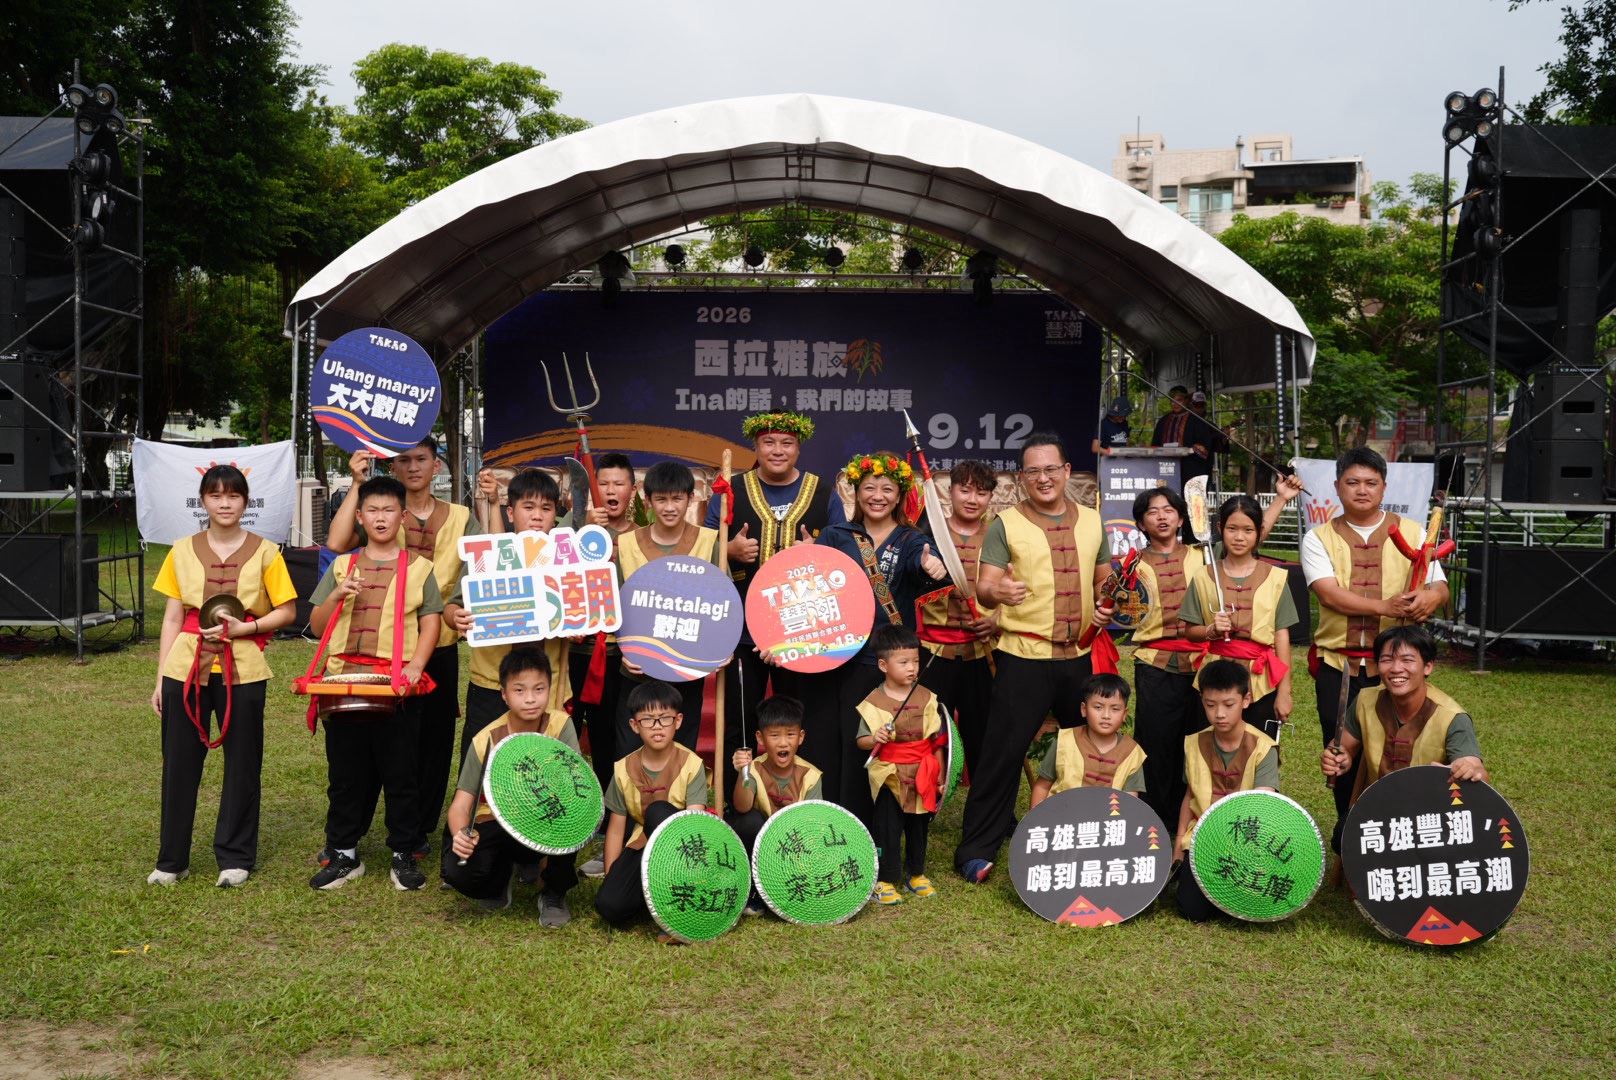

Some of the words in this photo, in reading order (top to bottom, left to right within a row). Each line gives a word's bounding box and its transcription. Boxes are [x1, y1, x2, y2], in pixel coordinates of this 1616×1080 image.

[697, 307, 751, 323] 2026
[369, 334, 408, 352] TAKAO
[695, 340, 848, 377] 西拉雅族
[322, 358, 375, 389] Uhang
[376, 376, 435, 403] maray!
[326, 382, 419, 427] 大大歡欣
[928, 413, 1034, 449] 9.12
[464, 530, 608, 574] TAKAO
[666, 561, 705, 575] TAKAO
[761, 569, 847, 608] TAKAO
[786, 564, 815, 580] 2026
[467, 567, 618, 642] 豐潮
[630, 589, 730, 622] Mitatalag!
[652, 613, 700, 642] 歡迎
[1026, 856, 1156, 893] 嗨到最高潮
[1366, 857, 1513, 902] 嗨到最高潮
